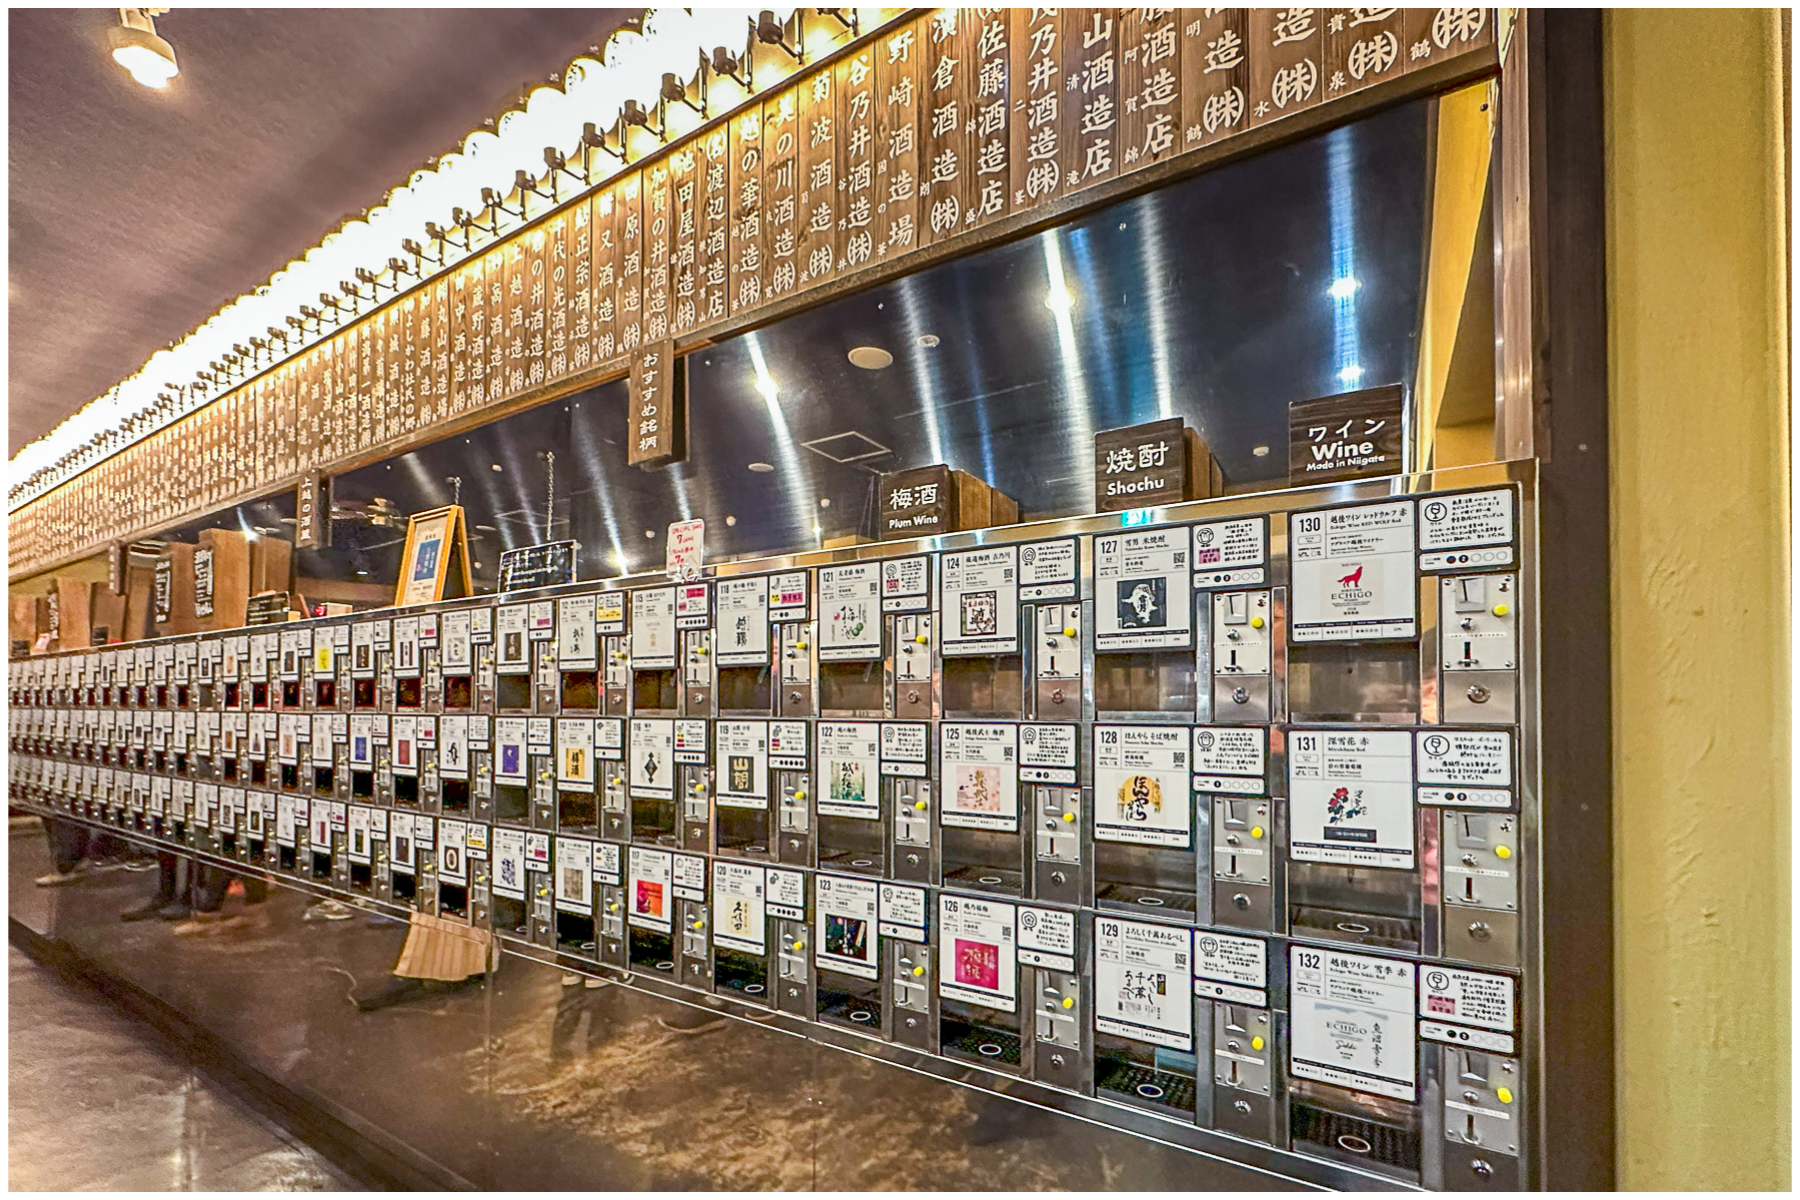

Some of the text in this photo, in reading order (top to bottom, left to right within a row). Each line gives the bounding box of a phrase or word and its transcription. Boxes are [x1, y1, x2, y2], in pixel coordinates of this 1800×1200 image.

[888, 30, 914, 247] 野崎酒造場
[639, 353, 659, 452] おすすめ銘柄
[1308, 419, 1386, 443] ワイン
[1105, 440, 1170, 474] 焼酎
[1311, 440, 1374, 461] Wine
[1306, 455, 1386, 471] Made in Niigata
[1107, 476, 1165, 496] Shochu
[889, 483, 939, 510] 梅酒
[889, 514, 939, 529] Plum Wine
[1330, 514, 1361, 524] 越後ワイン
[1363, 509, 1397, 520] レッドウルフ
[1299, 517, 1321, 533] 130
[1101, 540, 1118, 554] 127
[946, 557, 960, 570] 124
[822, 571, 834, 583] 121
[821, 726, 833, 737] 122
[945, 728, 960, 740] 125
[1100, 731, 1118, 744] 128
[1296, 737, 1316, 751] 131
[716, 865, 727, 876] 120
[819, 879, 832, 891] 123
[944, 899, 958, 912] 126
[1101, 923, 1118, 938] 129
[1298, 953, 1320, 969] 132
[1330, 958, 1370, 969] 越後ワイン
